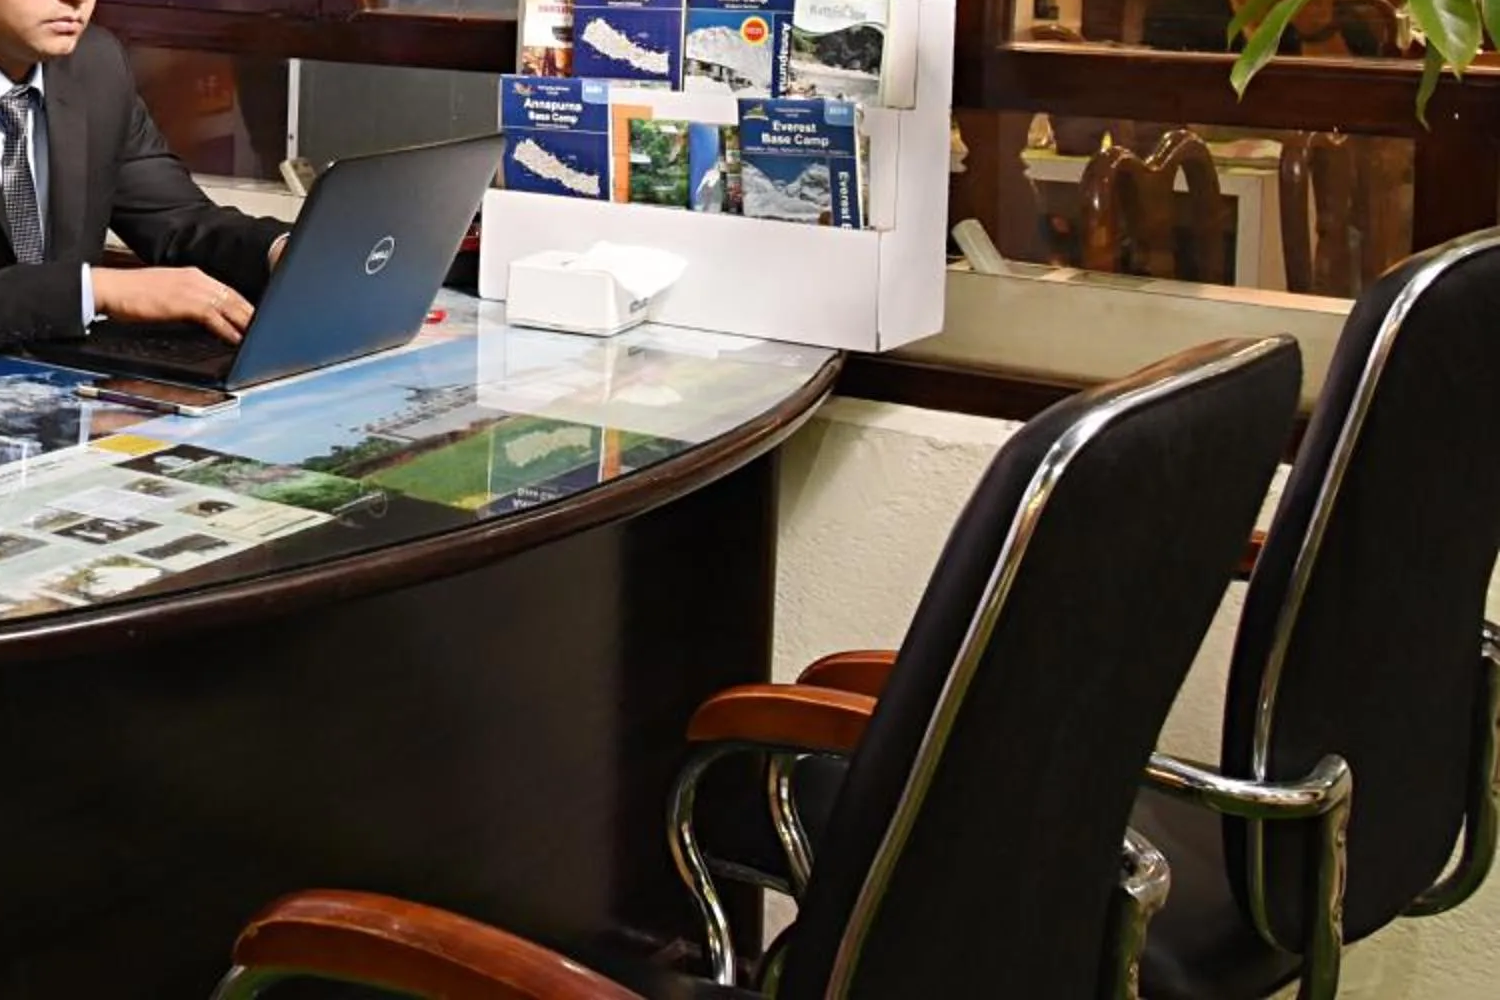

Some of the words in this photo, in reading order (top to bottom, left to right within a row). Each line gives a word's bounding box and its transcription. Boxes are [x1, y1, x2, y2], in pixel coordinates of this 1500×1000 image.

[524, 99, 582, 112] Annapurna
[528, 111, 550, 120] Base
[552, 113, 578, 124] Camp
[772, 121, 817, 133] Everest
[761, 133, 792, 144] Base
[794, 134, 829, 147] Camp
[838, 171, 851, 220] Everest
